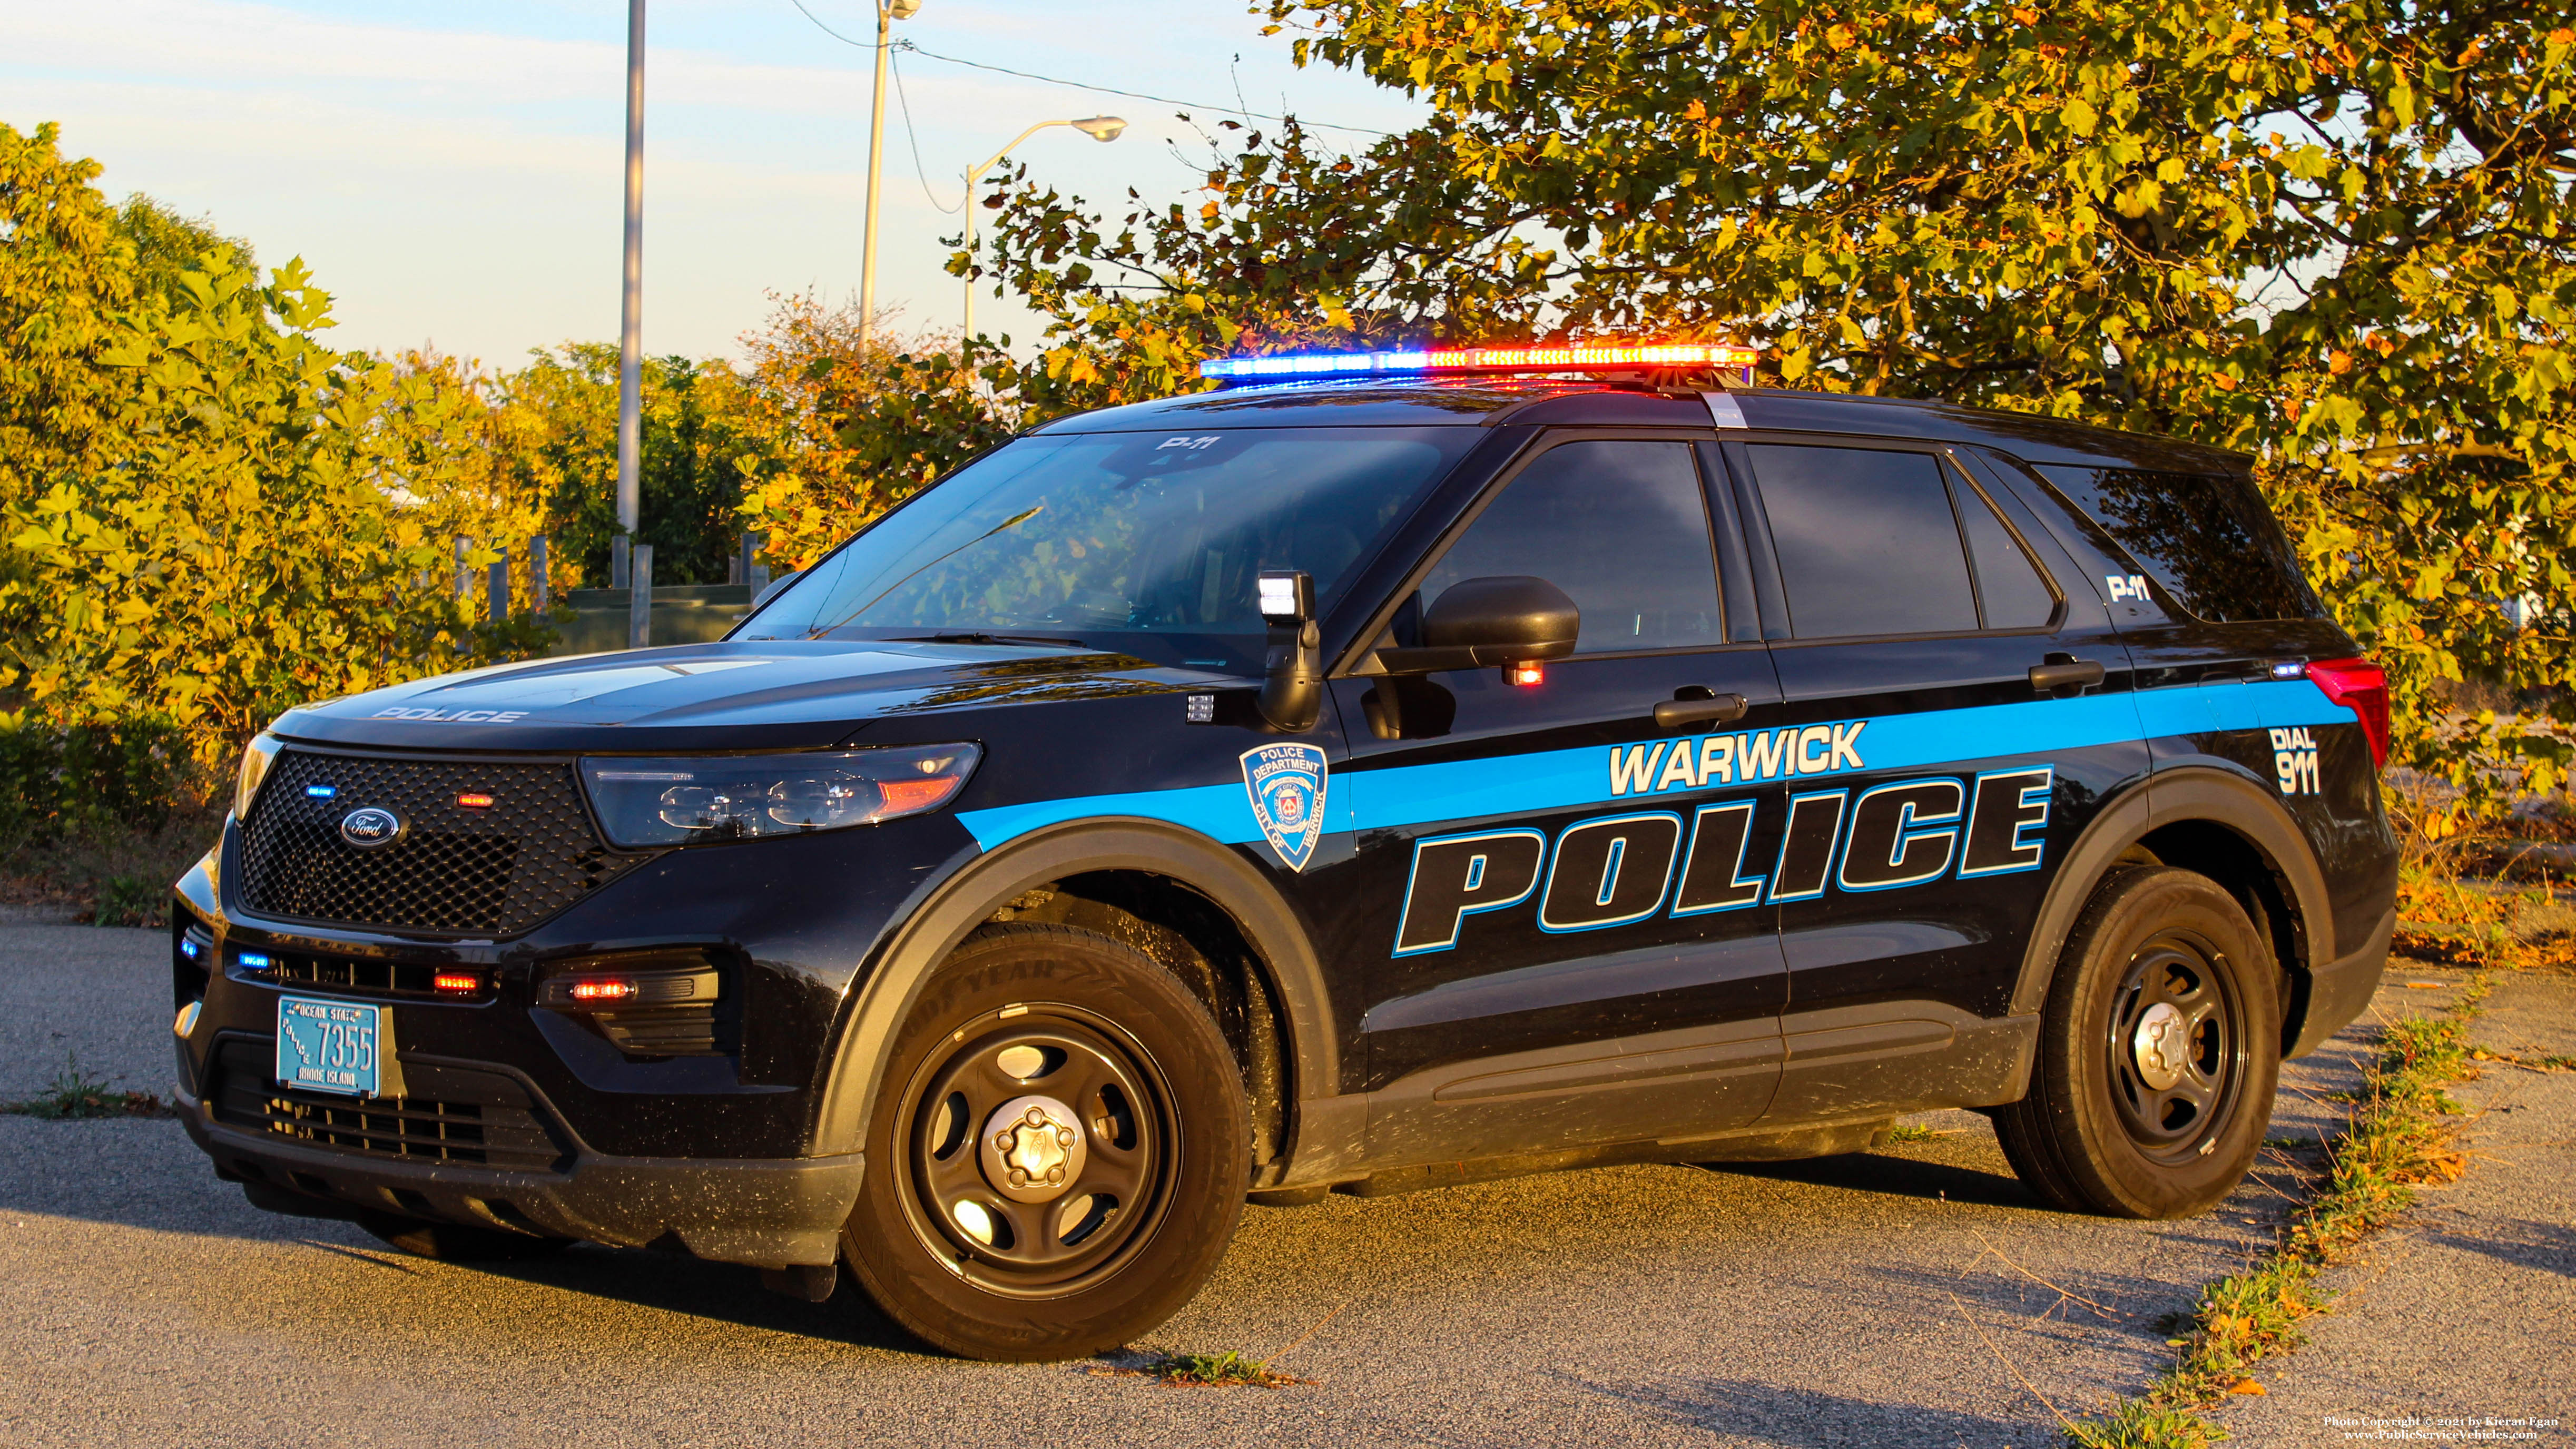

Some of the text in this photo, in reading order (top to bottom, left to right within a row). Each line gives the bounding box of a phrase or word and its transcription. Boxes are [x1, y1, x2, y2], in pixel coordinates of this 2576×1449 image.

[1155, 436, 1222, 450] P-11
[2105, 575, 2151, 603] P-11
[371, 707, 530, 723] POLICE
[2268, 727, 2317, 750] DIAL
[1260, 747, 1304, 762] POLICE
[1609, 721, 1869, 796] WARWICK
[1253, 757, 1320, 780] DEPARTMENT
[2276, 751, 2320, 795] 911
[351, 815, 384, 837] Ford
[1255, 803, 1285, 849] CITY OF
[1303, 791, 1323, 849] WARWICK
[1391, 764, 2054, 958] POLICE
[299, 1004, 326, 1019] OCEAN
[282, 1017, 310, 1064] POLICE
[317, 1022, 372, 1071] 7355
[298, 1067, 355, 1086] RHODE ISLAND
